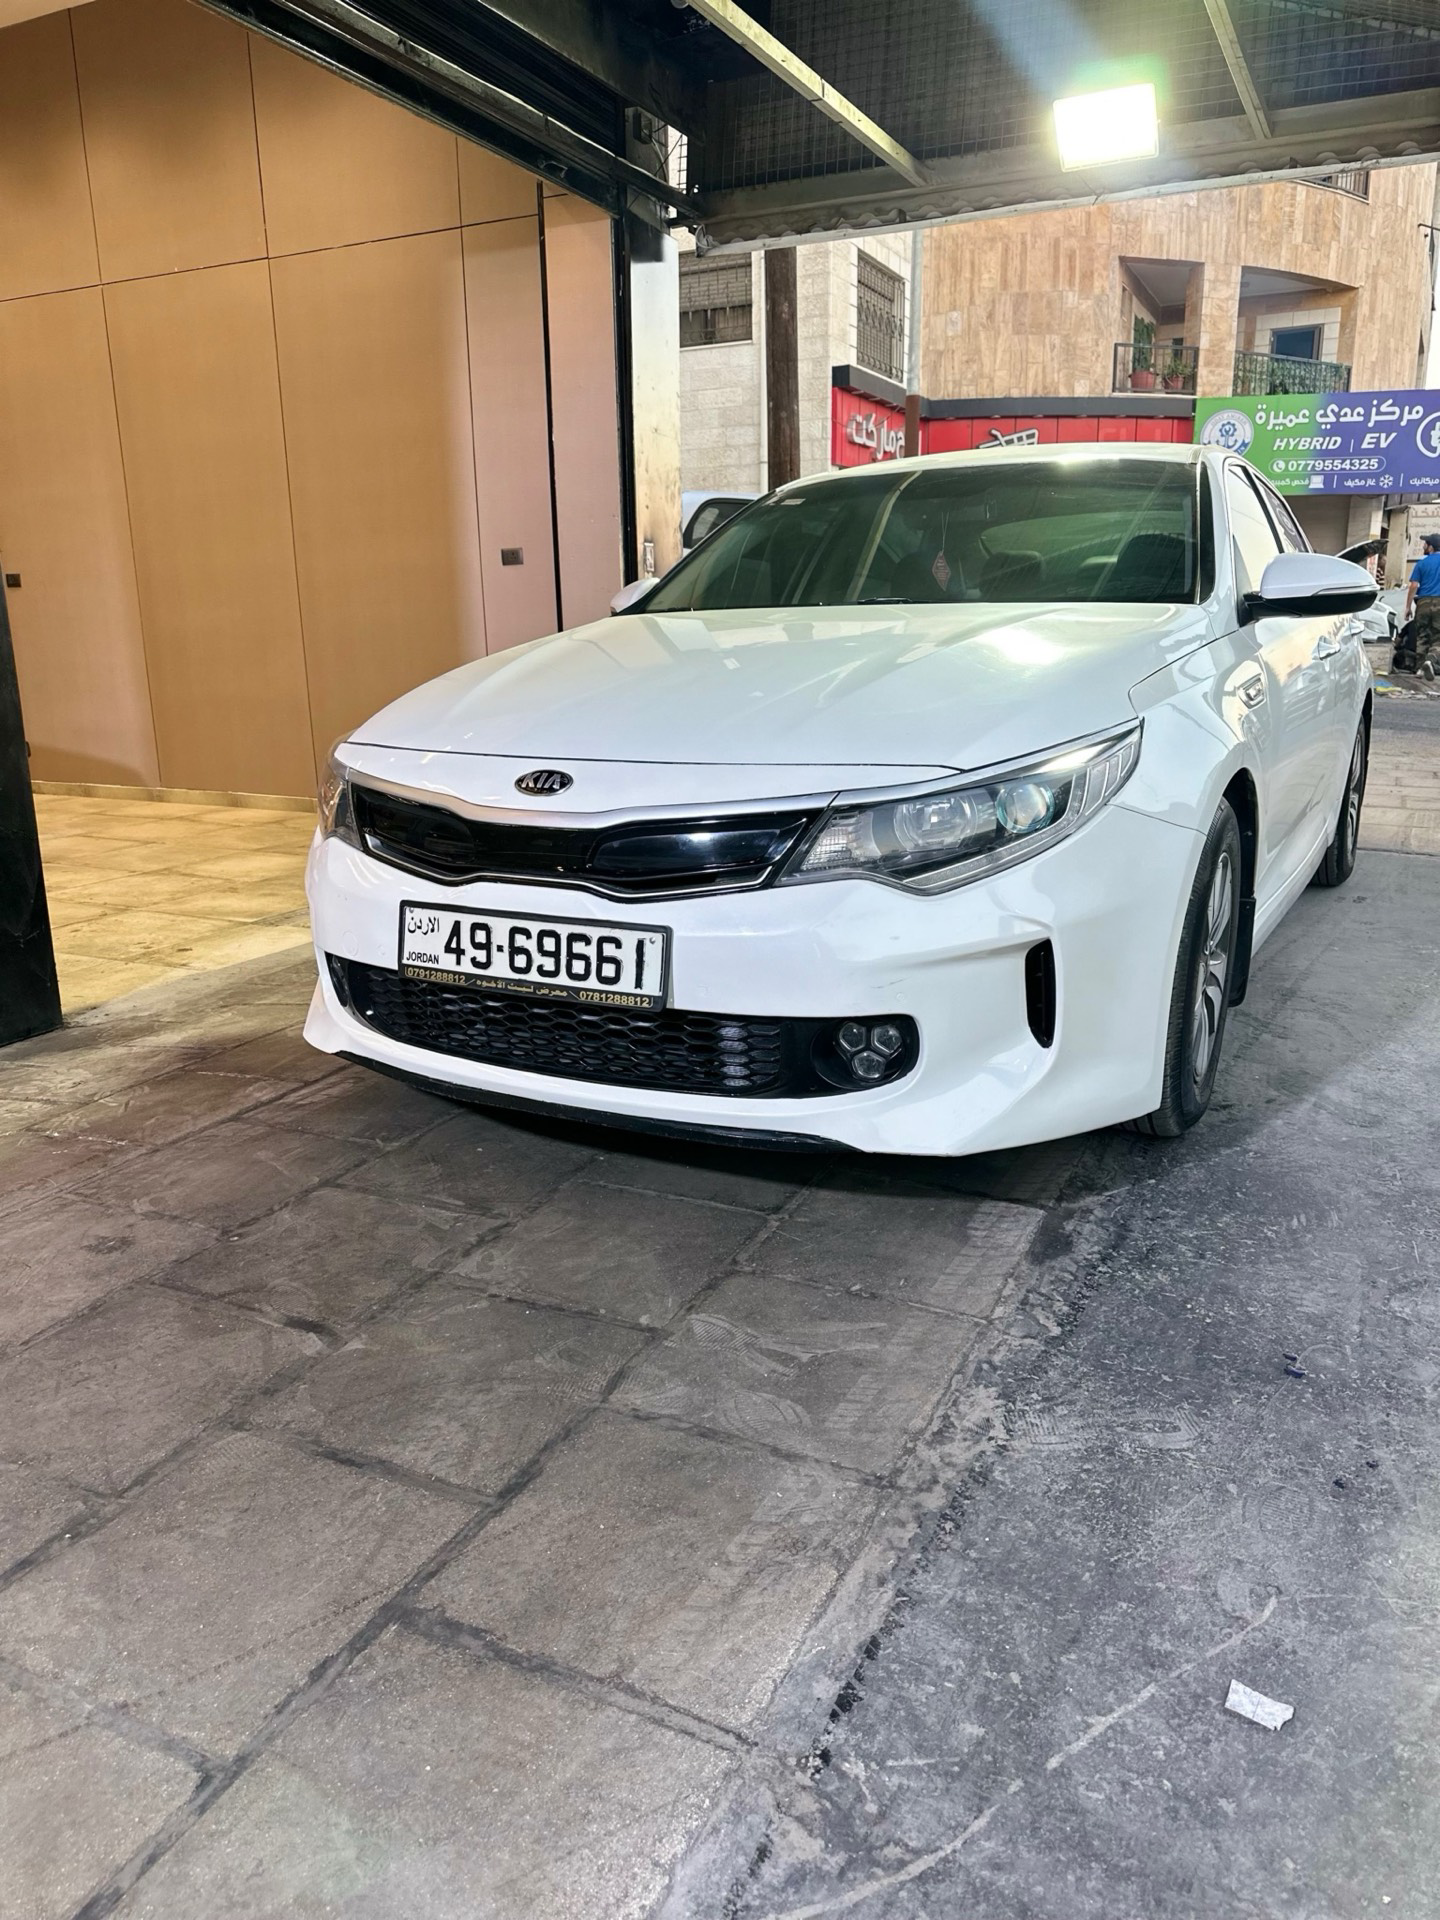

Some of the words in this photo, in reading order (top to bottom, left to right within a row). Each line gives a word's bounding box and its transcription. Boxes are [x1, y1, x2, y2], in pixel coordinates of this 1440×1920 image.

[1255, 403, 1310, 431] عميرة
[1315, 403, 1365, 429] عدي
[1367, 399, 1424, 427] مركز
[1272, 436, 1342, 451] HYBRID
[1360, 432, 1398, 449] EV
[1288, 458, 1379, 472] 0779554325
[521, 772, 562, 790] KIA
[406, 951, 440, 965] JORDAN
[408, 967, 466, 984] 0791288812
[536, 986, 568, 997] معرض
[579, 990, 650, 1007] 0781288812
